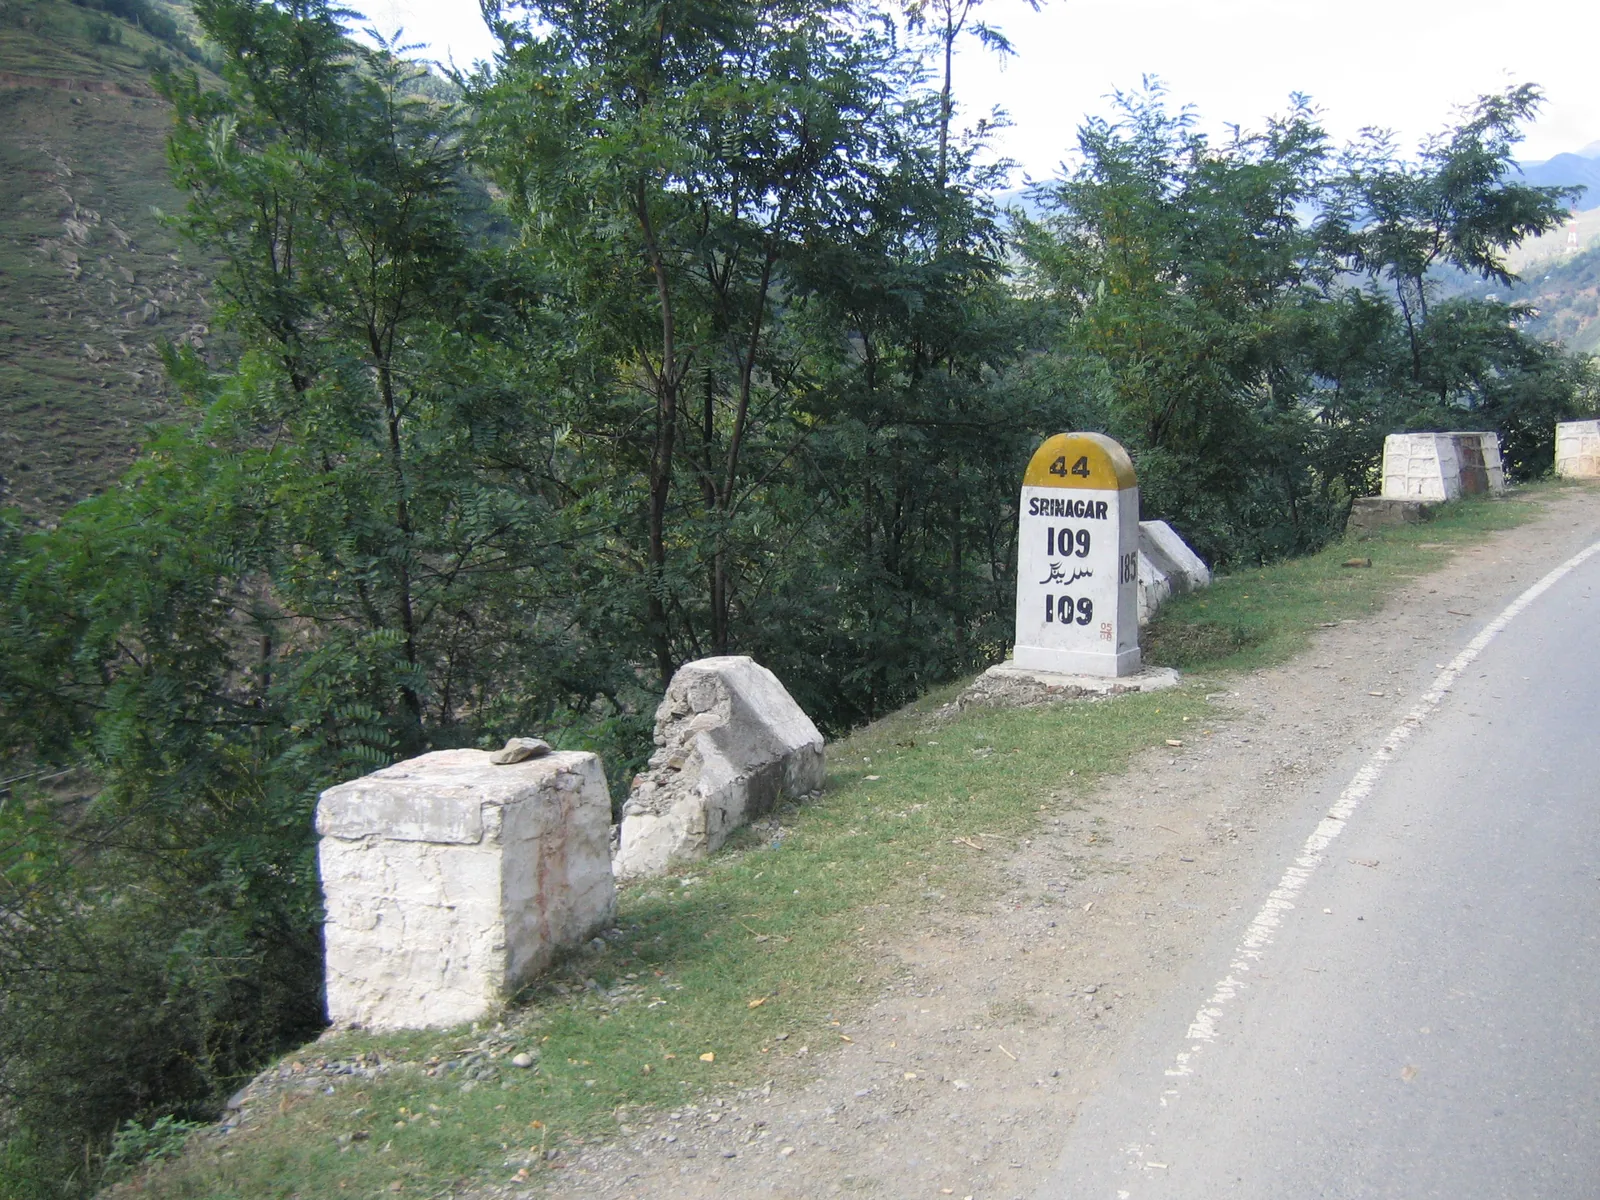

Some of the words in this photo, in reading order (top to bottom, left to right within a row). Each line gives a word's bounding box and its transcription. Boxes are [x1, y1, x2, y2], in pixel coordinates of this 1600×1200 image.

[1049, 456, 1091, 478] 44
[1028, 497, 1108, 520] SRINAGAR
[1047, 527, 1091, 558] 109
[1121, 551, 1136, 584] 185
[1045, 594, 1093, 626] 109
